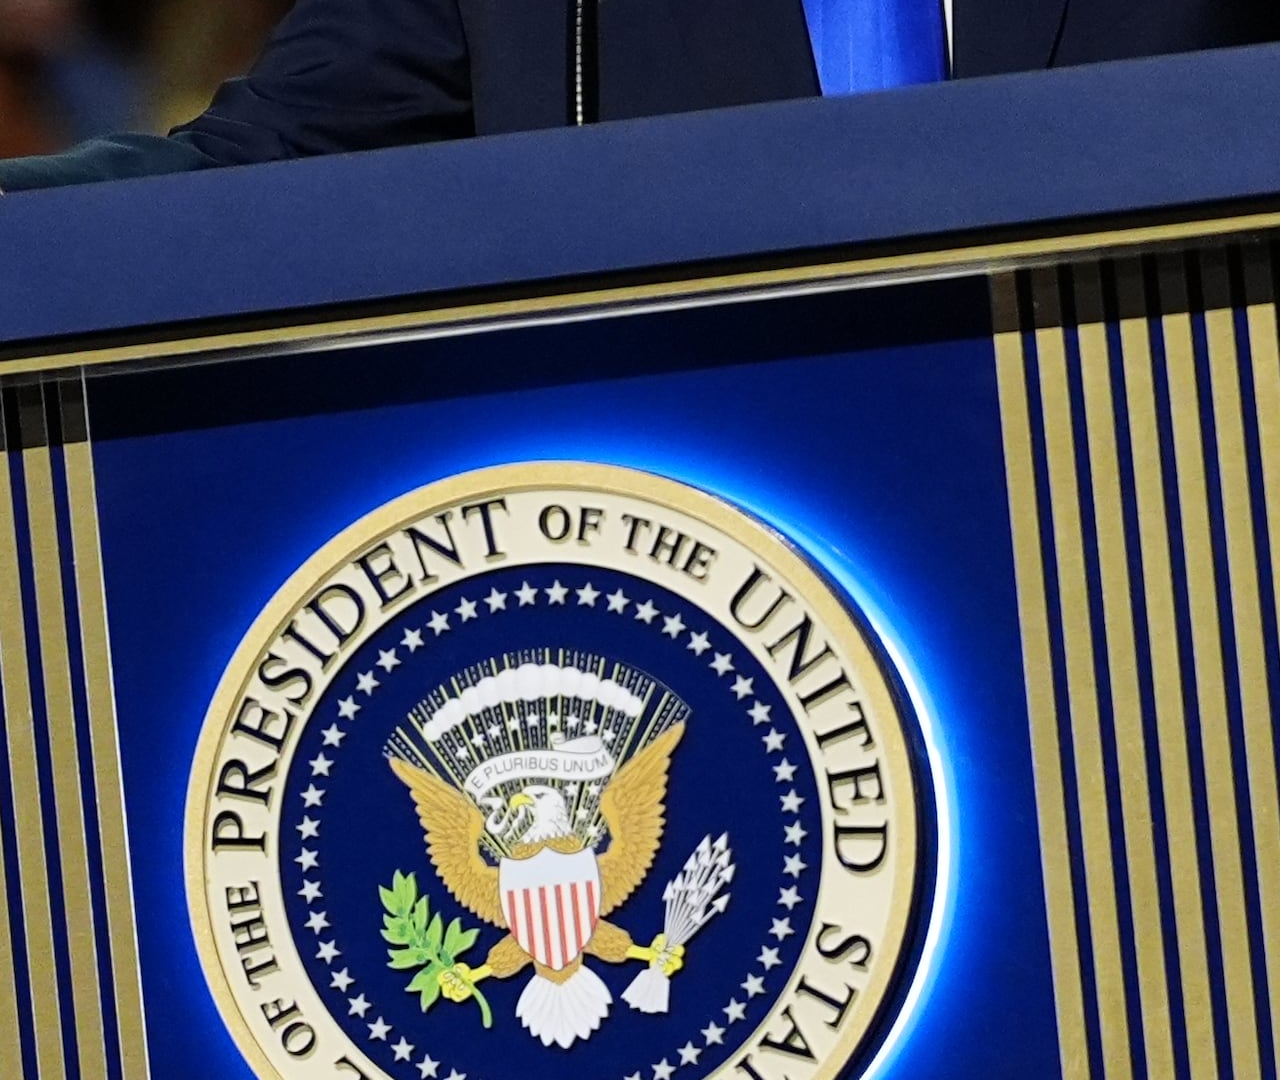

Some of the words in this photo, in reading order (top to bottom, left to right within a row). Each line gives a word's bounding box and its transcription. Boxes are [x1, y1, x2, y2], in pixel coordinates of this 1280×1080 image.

[538, 504, 603, 541] OF
[622, 513, 716, 581] THE
[212, 499, 507, 853] PRESIDENT
[730, 563, 888, 873] UNITED
[472, 775, 482, 789] E
[483, 756, 559, 780] PLURIBUS
[563, 753, 609, 772] UNUM
[226, 881, 279, 989] THE
[261, 999, 315, 1056] OF
